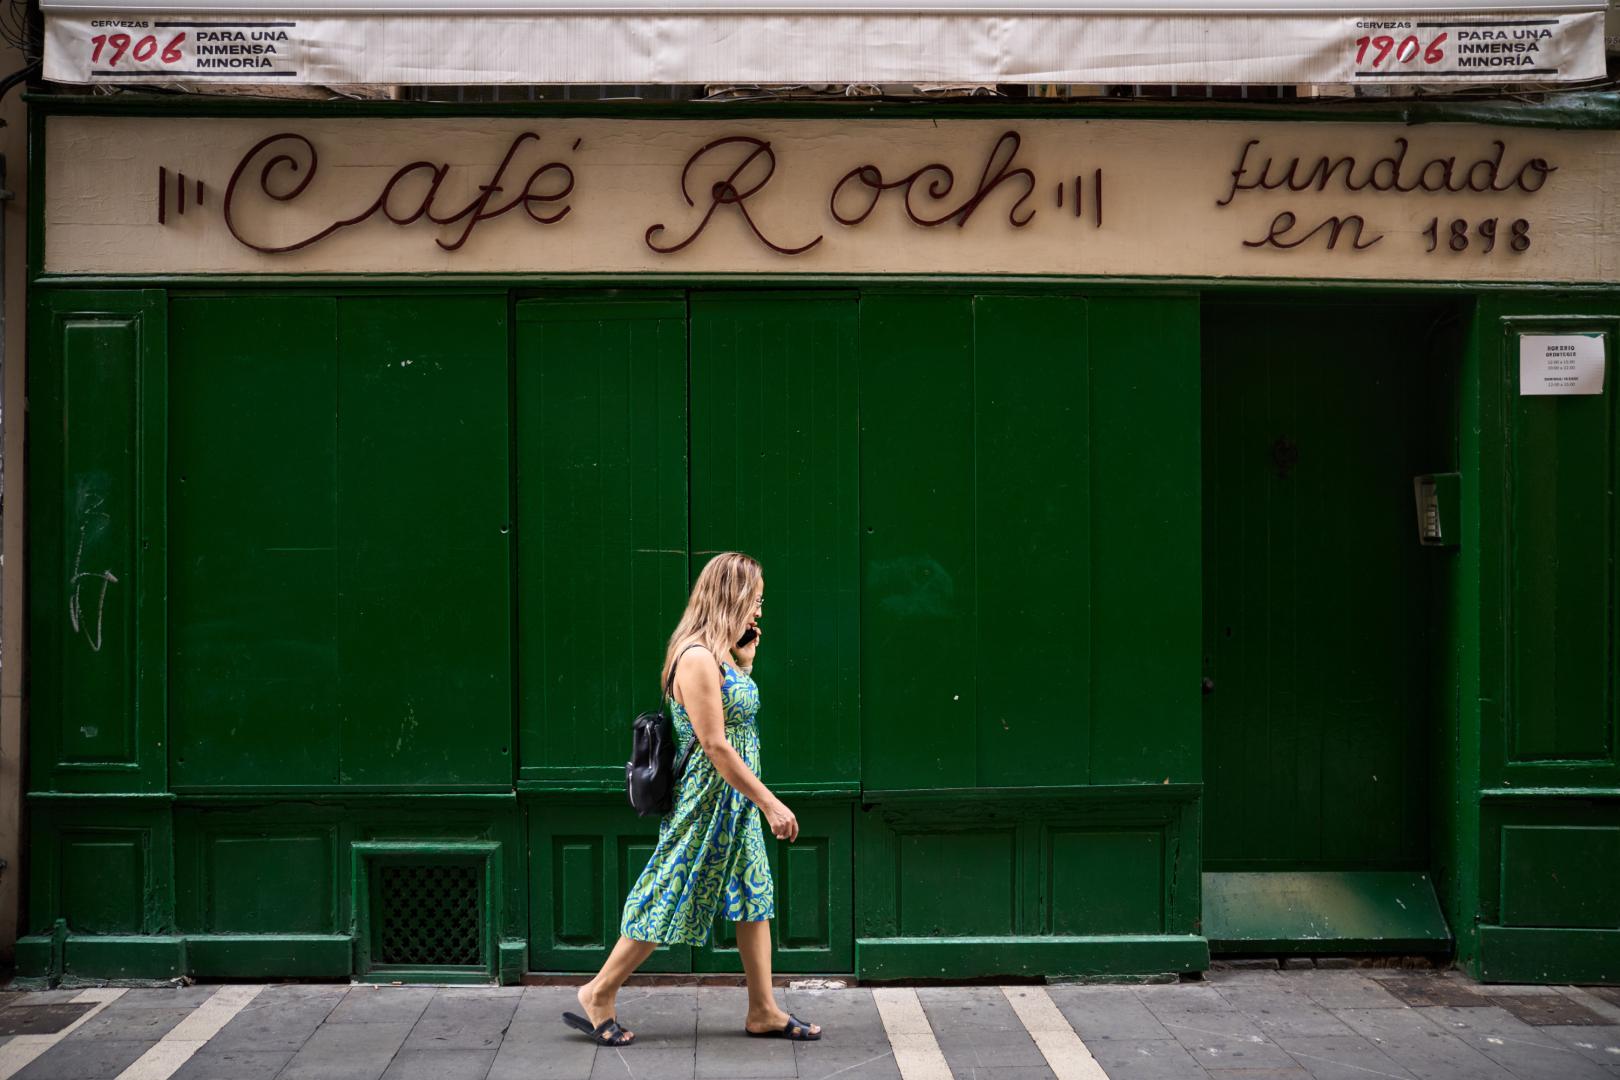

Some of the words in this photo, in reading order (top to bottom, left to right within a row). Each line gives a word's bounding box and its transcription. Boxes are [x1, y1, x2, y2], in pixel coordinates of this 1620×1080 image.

[91, 20, 149, 28] CERVEZAS
[1356, 21, 1411, 29] CERVEZAS
[196, 32, 246, 42] PARA
[250, 31, 289, 41] UNA
[1457, 31, 1508, 41] PARA
[1513, 28, 1553, 40] UNA
[91, 32, 186, 67] 1906
[196, 44, 277, 55] INMENSA
[1355, 32, 1448, 68] 1906
[1457, 43, 1540, 54] INMENSA
[196, 56, 273, 68] MINORÍA
[1457, 54, 1535, 67] MINORÍA
[1216, 137, 1558, 207] fundado
[223, 132, 582, 253] Café
[645, 130, 1036, 255] Roch
[1242, 211, 1384, 250] en
[1422, 216, 1531, 254] 1898
